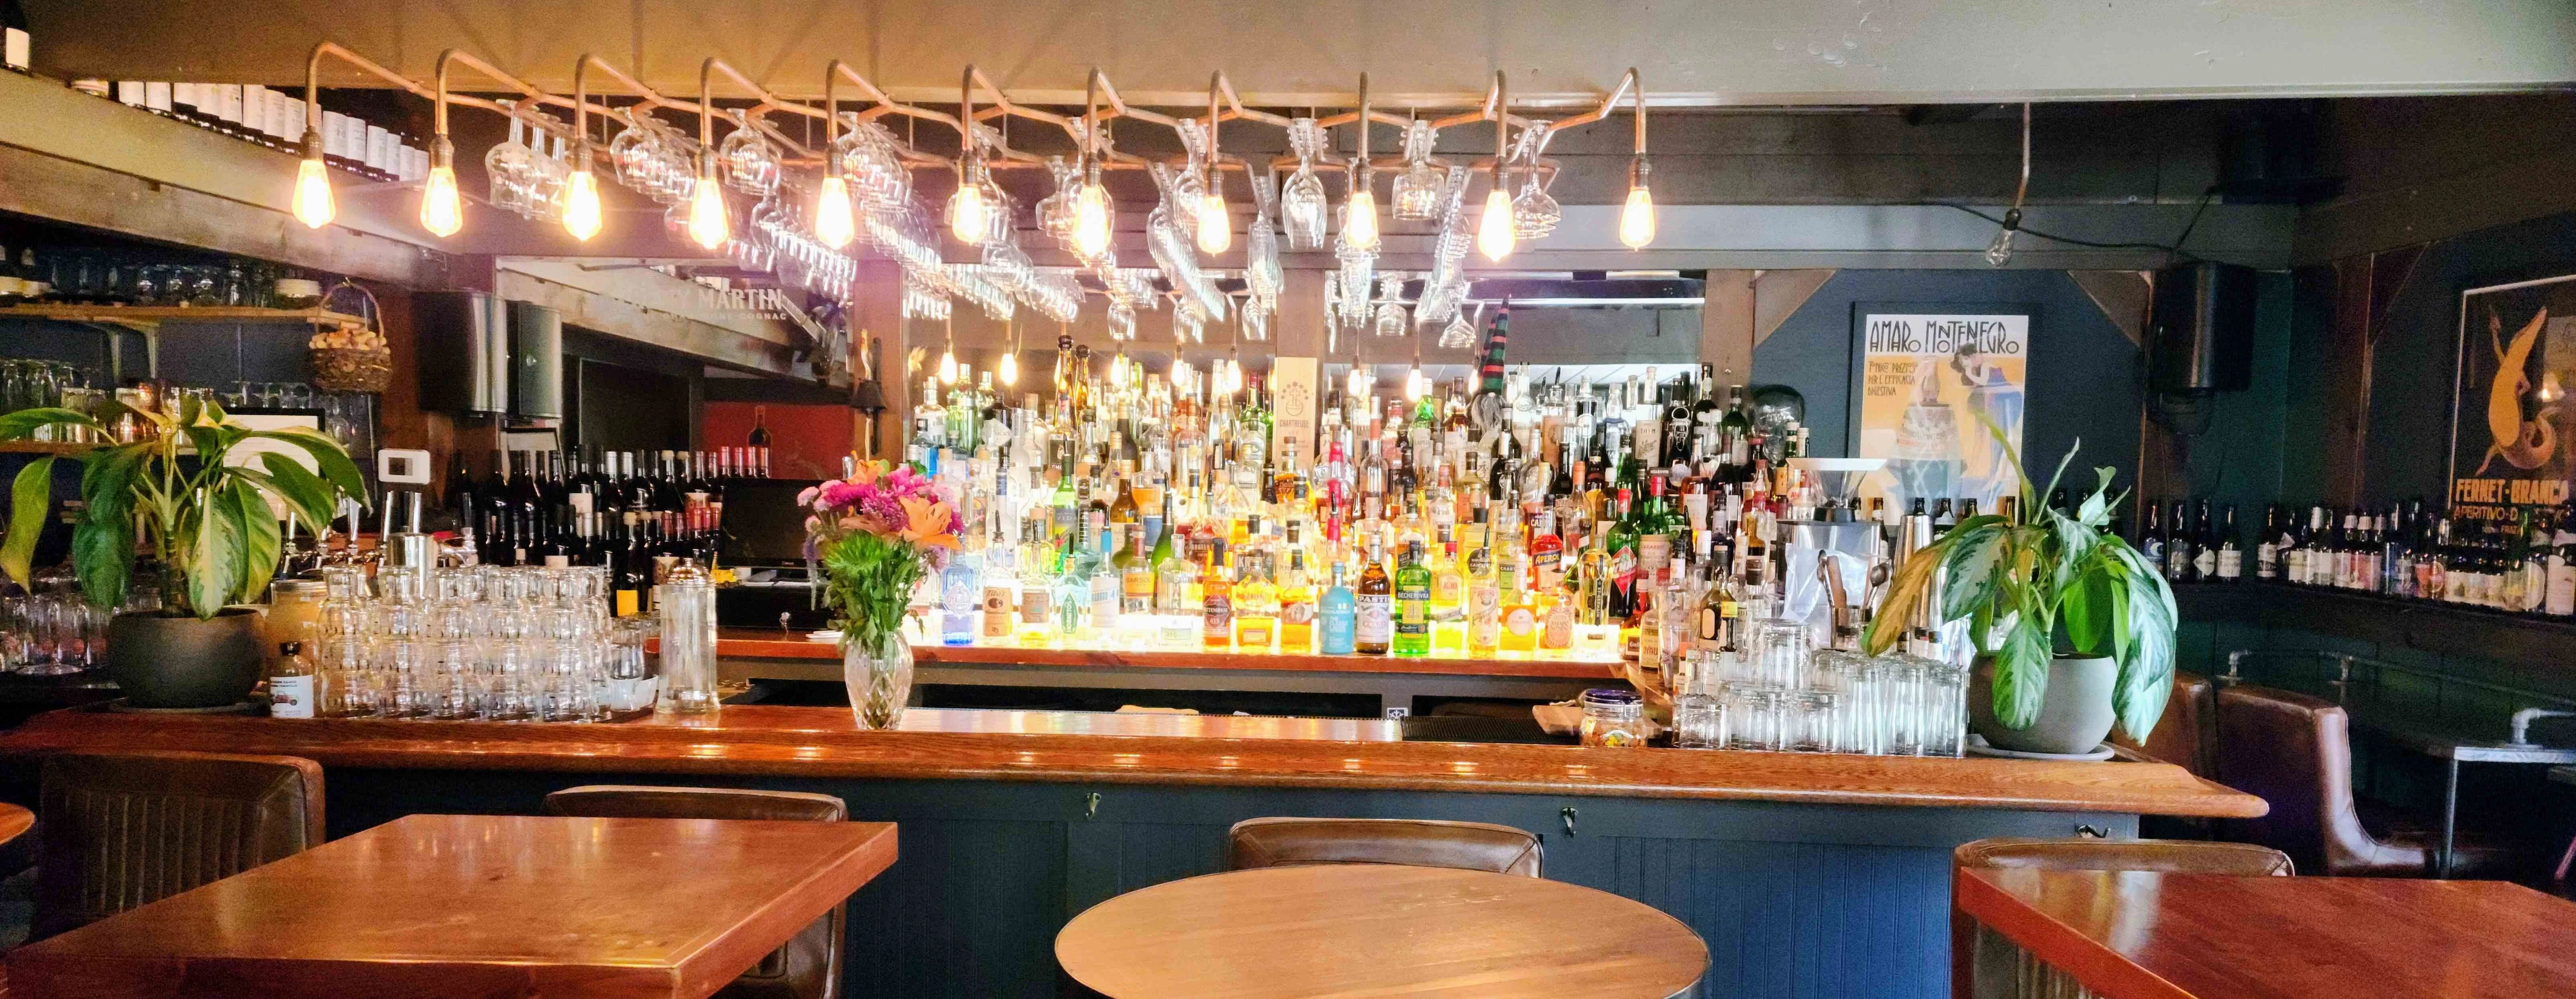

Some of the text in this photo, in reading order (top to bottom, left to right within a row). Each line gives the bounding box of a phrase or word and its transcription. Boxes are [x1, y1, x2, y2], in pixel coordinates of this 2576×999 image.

[698, 288, 782, 310] MARTIN
[1870, 320, 1921, 352] AMARO
[1868, 375, 1877, 384] PER
[1280, 419, 1309, 428] CHARTREUSE
[2454, 506, 2519, 521] APERITIVO-D
[1535, 553, 1560, 565] APEROL
[1643, 646, 1658, 656] OYAU
